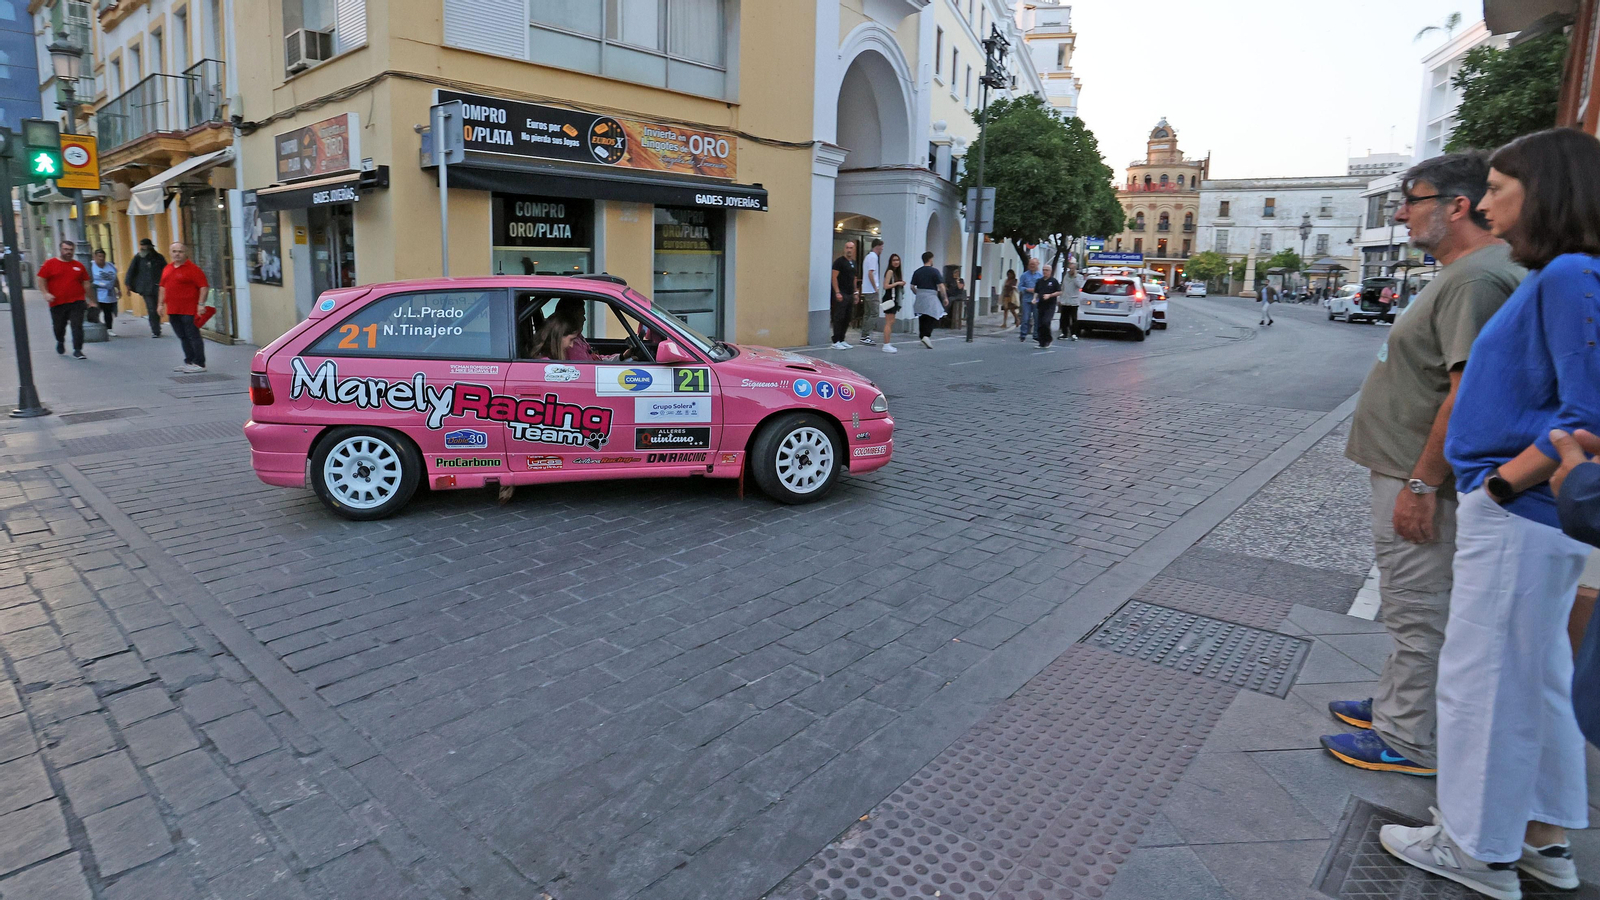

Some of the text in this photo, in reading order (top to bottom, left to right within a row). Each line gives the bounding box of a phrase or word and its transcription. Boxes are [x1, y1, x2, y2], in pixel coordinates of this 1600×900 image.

[462, 103, 506, 124] OMPRO
[526, 118, 561, 133] Euros por
[643, 125, 677, 141] Invierta
[464, 125, 514, 146] O/PLATA
[521, 131, 580, 148] No pierda sus Joyas
[641, 137, 689, 153] Lingotes de
[688, 134, 729, 158] ORO
[695, 193, 760, 208] GADES JOYERÍAS
[515, 201, 565, 218] COMPRO
[509, 222, 572, 239] ORO/PLATA
[662, 224, 709, 239] ORO/PLATA
[393, 306, 464, 319] J.L.Prado
[338, 323, 378, 349] 21
[383, 323, 463, 339] N.Tinajero
[678, 369, 705, 391] 21
[469, 434, 483, 443] 30
[508, 422, 584, 446] Team
[641, 432, 694, 445] Quintano
[435, 457, 501, 468] ProCarbono
[677, 452, 707, 462] RACING
